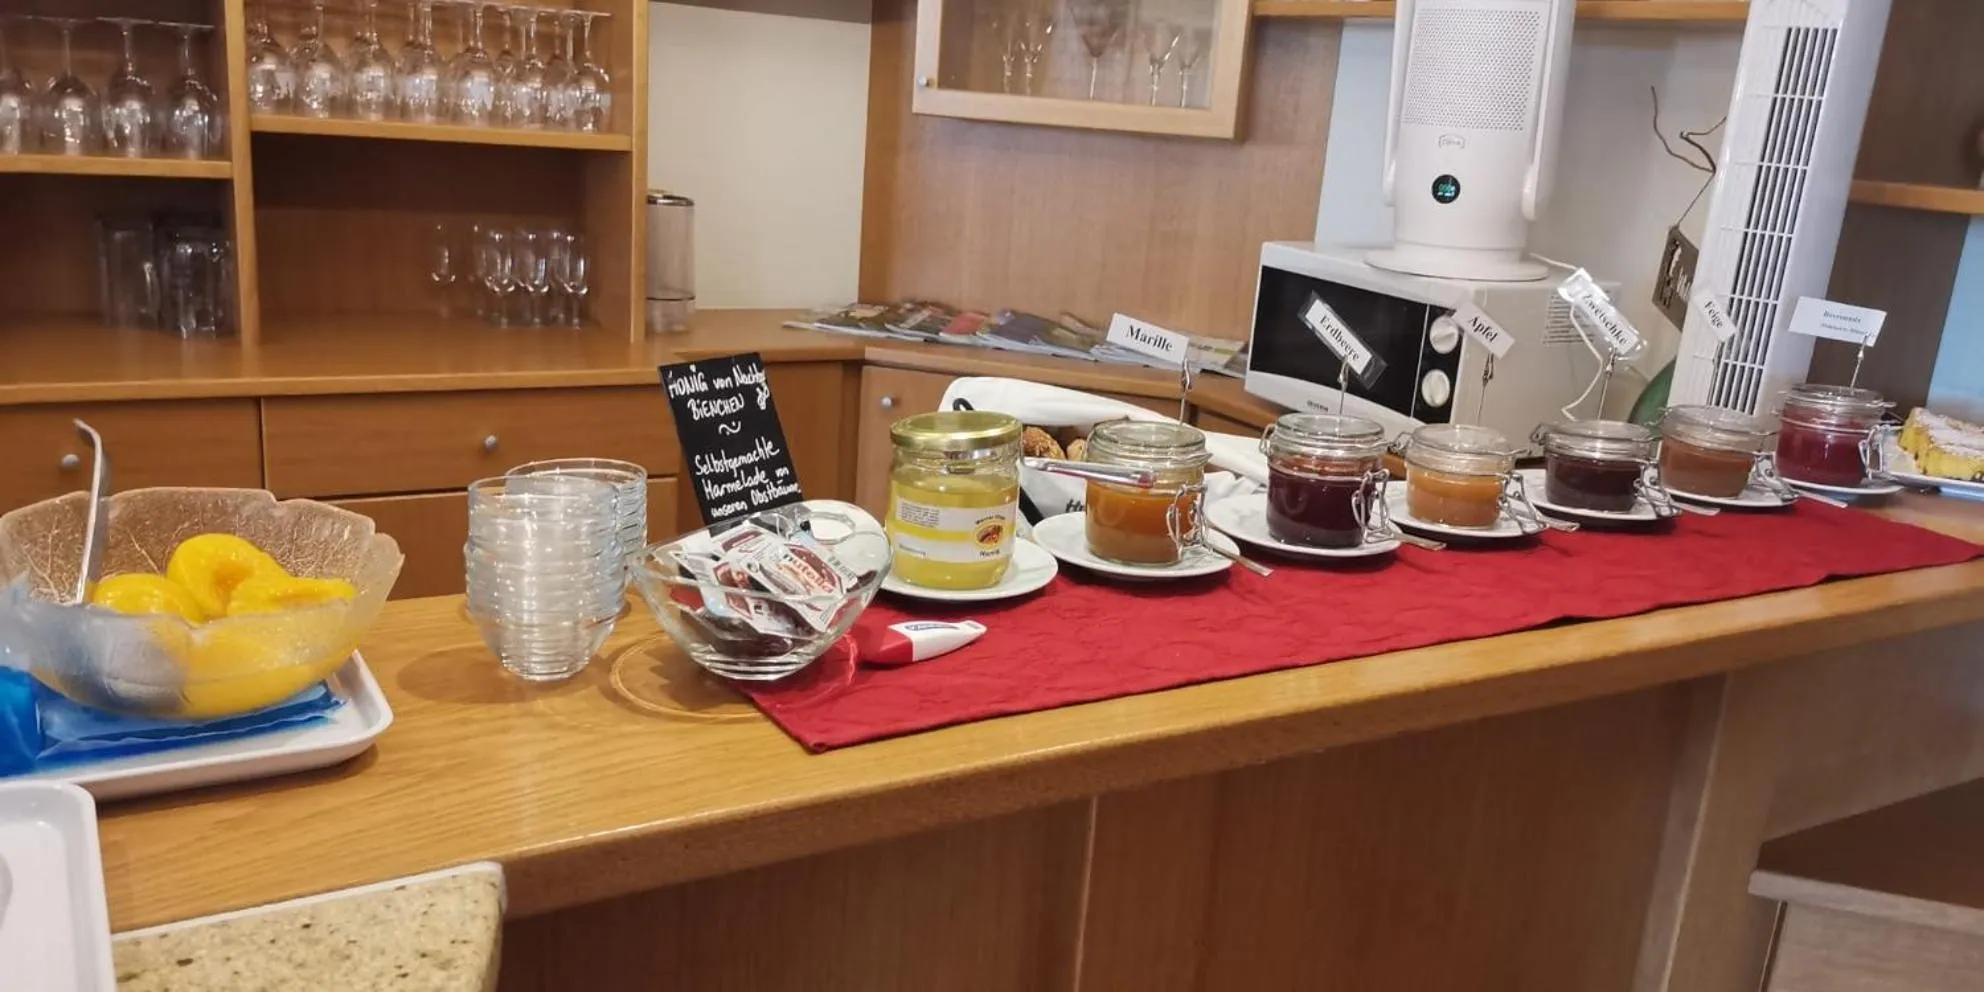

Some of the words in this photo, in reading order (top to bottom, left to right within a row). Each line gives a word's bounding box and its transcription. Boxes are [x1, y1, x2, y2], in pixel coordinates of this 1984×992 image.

[1582, 294, 1628, 345] Zwetschke
[1704, 300, 1723, 328] Feige
[1126, 324, 1173, 352] Marille
[1320, 315, 1360, 361] Erdbeere
[1468, 316, 1498, 343] Apfel
[712, 376, 734, 390] von
[694, 435, 780, 478] Selbstgemachte
[711, 500, 748, 518] unseren
[783, 553, 835, 594] nutella
